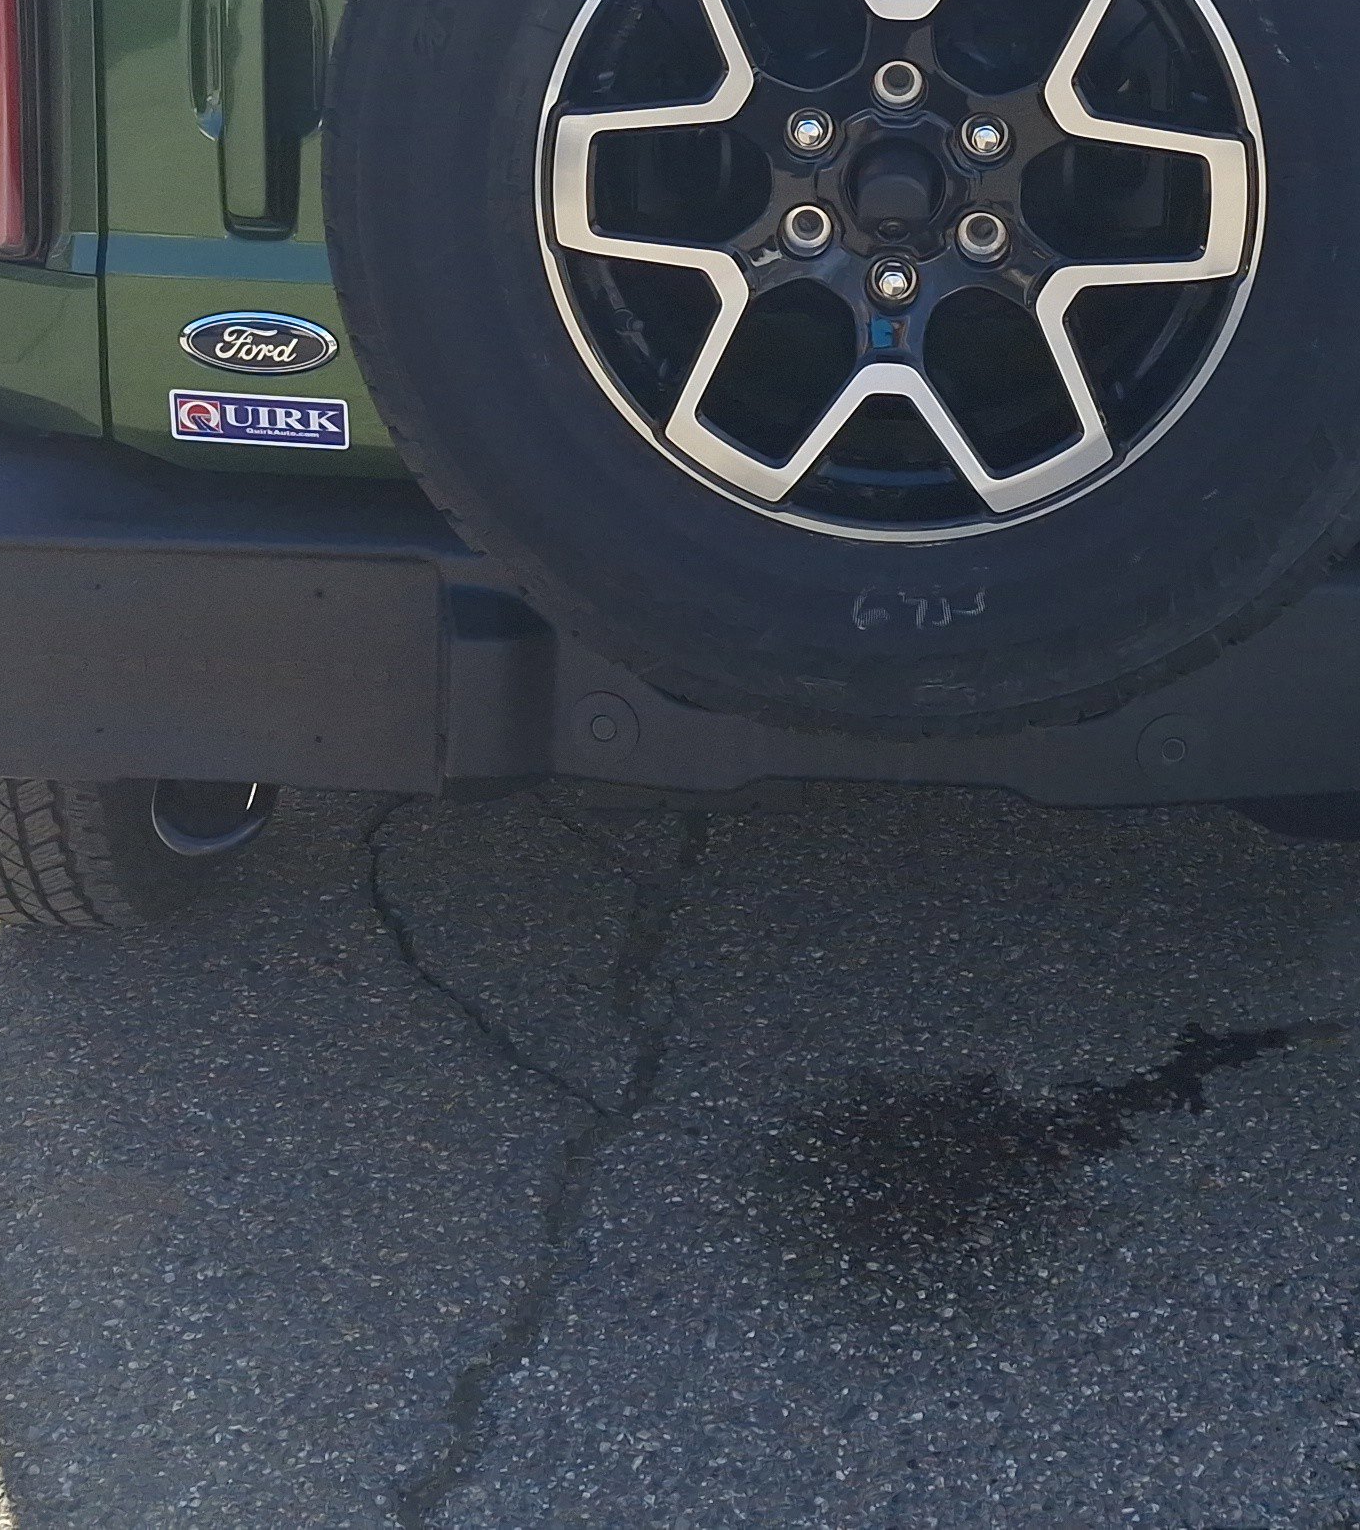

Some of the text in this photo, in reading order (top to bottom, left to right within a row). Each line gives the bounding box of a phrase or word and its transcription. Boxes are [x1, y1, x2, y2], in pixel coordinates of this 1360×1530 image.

[215, 325, 297, 363] Ford
[178, 401, 342, 434] QUIRK
[245, 427, 320, 439] QuirkAuto.com
